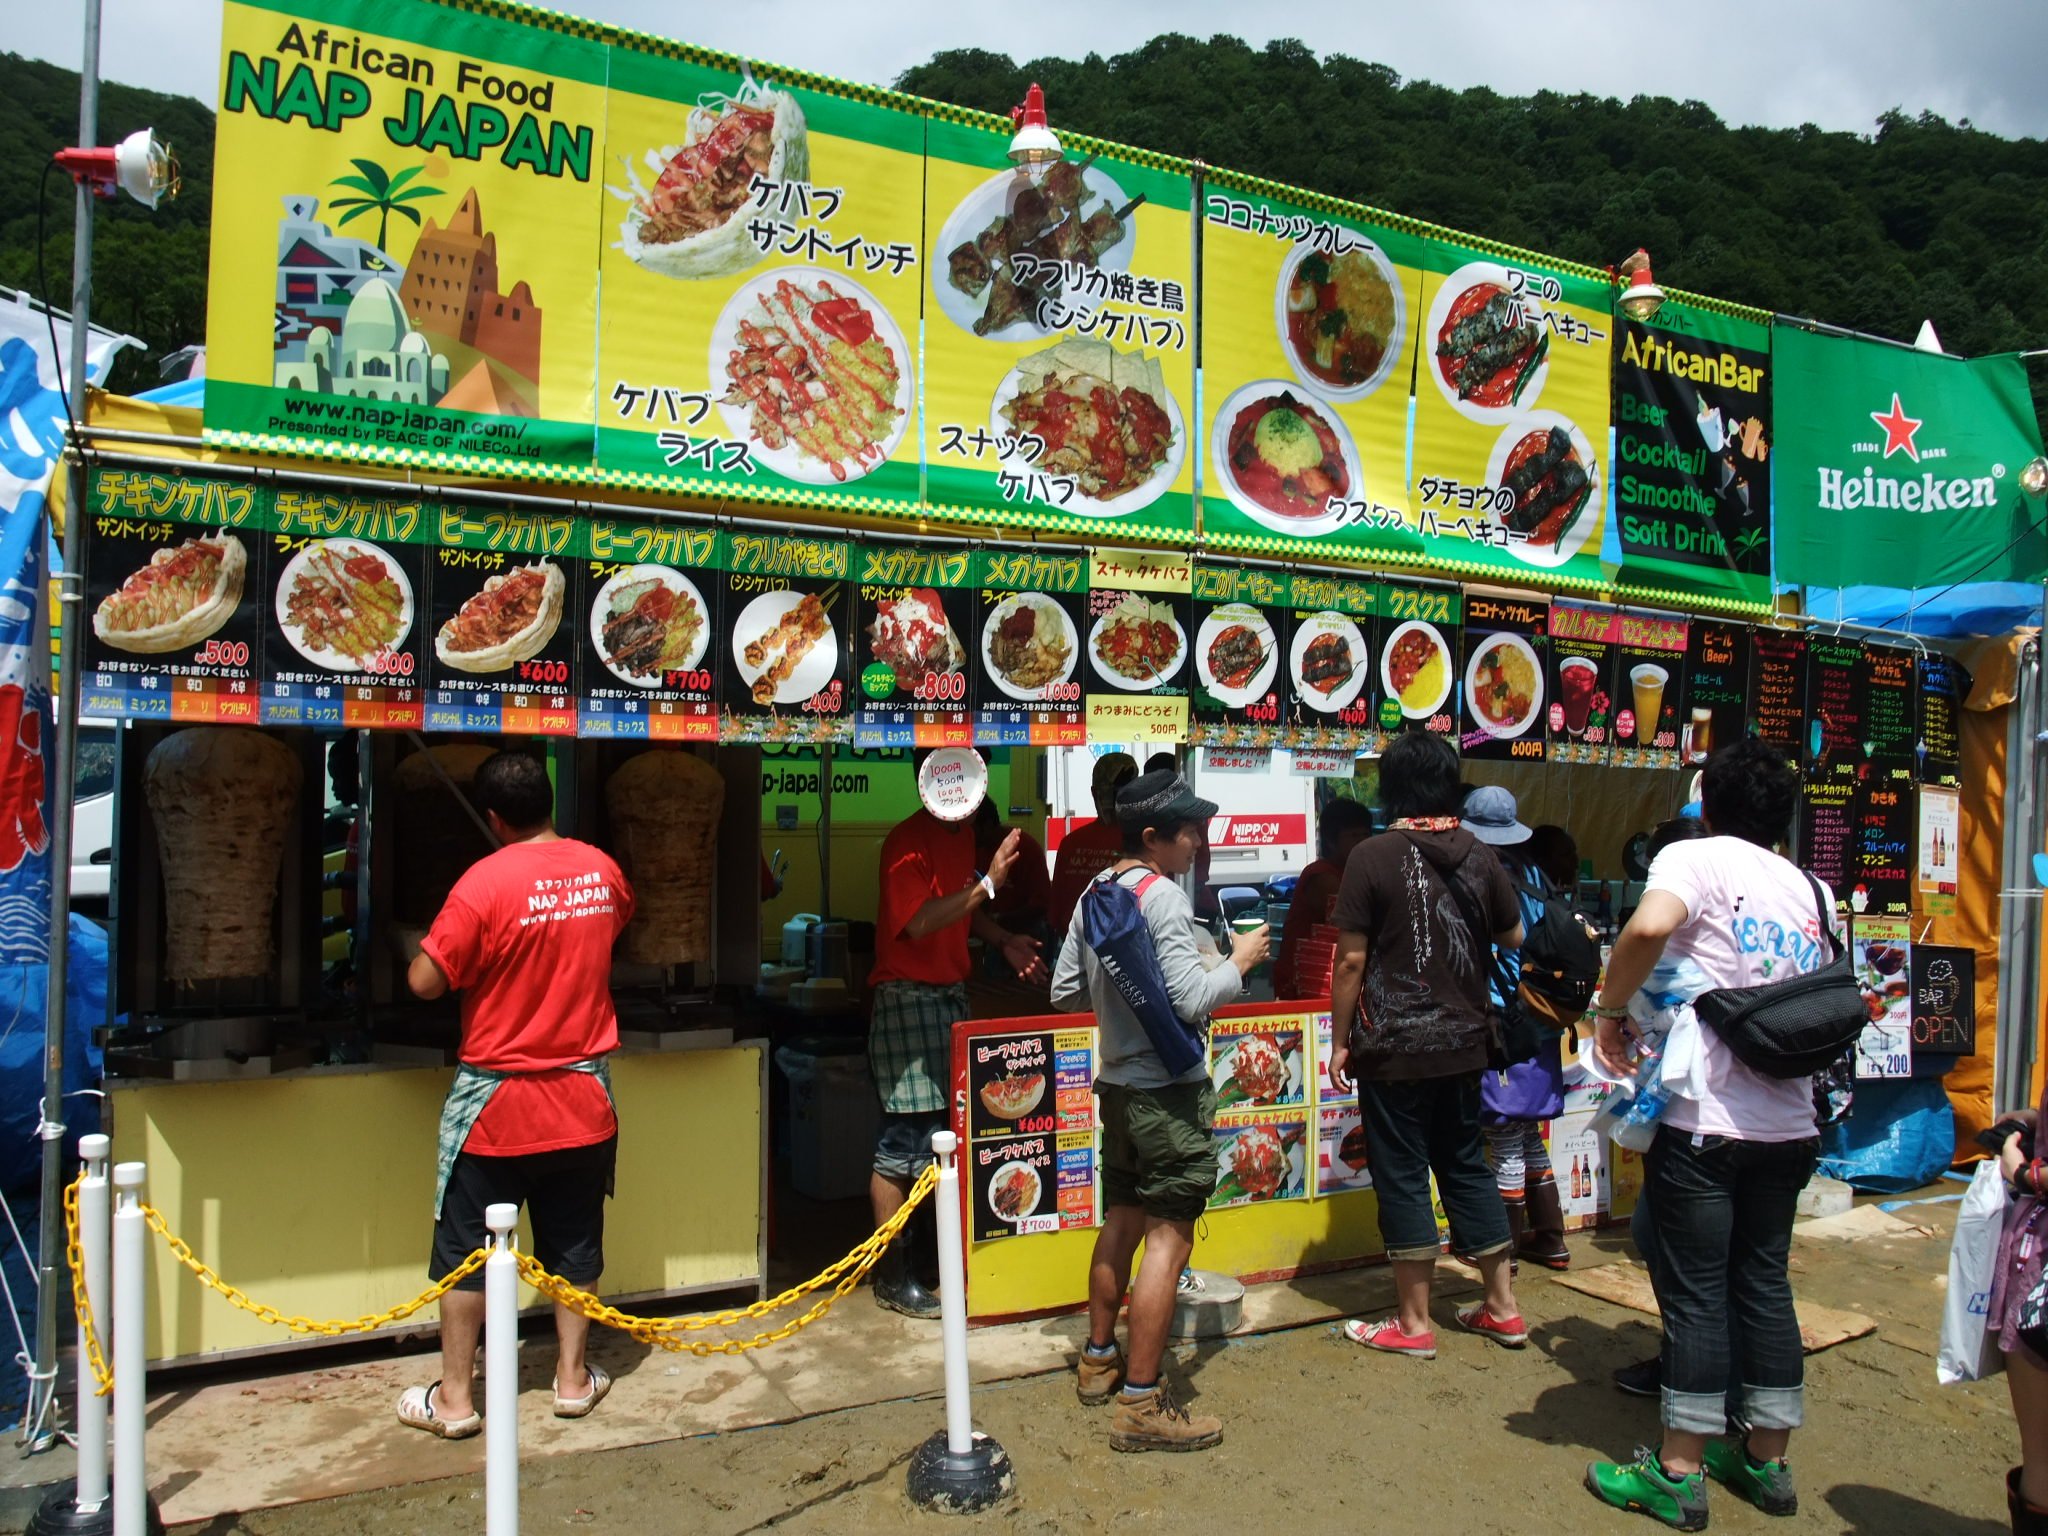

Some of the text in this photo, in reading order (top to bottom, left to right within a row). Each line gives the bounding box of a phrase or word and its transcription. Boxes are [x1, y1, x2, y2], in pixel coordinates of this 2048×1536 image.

[277, 22, 553, 112] African Food
[224, 51, 593, 182] NAP JAPAN
[749, 176, 844, 221] ケバブ
[1207, 195, 1376, 255] ココナッツカレー
[747, 219, 916, 275] サンドイッチ
[1011, 253, 1185, 312] アフリカ焼き鳥
[1505, 268, 1562, 302] ワニの
[1036, 298, 1186, 350] (シシケバブ)
[1503, 301, 1606, 345] バーベキュー
[1621, 331, 1765, 394] AfricanBar
[612, 382, 713, 425] ケバブ
[1621, 393, 1669, 427] Beer
[284, 397, 527, 439] www.nap-japan.com/
[268, 417, 347, 437] Presented
[354, 425, 371, 441] by
[375, 428, 428, 446] PEACE
[433, 433, 453, 449] OF
[939, 425, 1046, 463] スナック
[1852, 443, 1947, 459] TRADE MARK
[657, 432, 756, 475] ライス
[1621, 435, 1707, 475] Cocktail
[997, 469, 1078, 506] ケバブ
[1418, 475, 1515, 514] ダチョウの
[1621, 475, 1717, 517] Smoothie
[1818, 466, 1999, 513] Heineken
[98, 472, 256, 526] チキンケバブ
[275, 492, 421, 541] チキンケバブ
[1324, 495, 1413, 532] クスクス
[97, 518, 174, 542] サンドイッチ
[439, 505, 575, 554] ビーフケバブ
[1418, 510, 1529, 548] バーベキュー
[1623, 514, 1728, 556] Soft Drink
[275, 534, 328, 557] ライス
[590, 521, 717, 566] ビーフケバブ
[439, 549, 505, 570] サンドイッチ
[732, 535, 848, 578] アフリカやきとり
[590, 561, 634, 580] ライス
[861, 550, 969, 587] メガケバブ
[985, 554, 1082, 592] メガケバブ
[1097, 562, 1188, 581] スナックケバブ
[730, 575, 791, 592] (シシケバブ)
[1194, 567, 1284, 603] ワニのバーベキュー
[861, 585, 912, 602] サンドイッチ
[982, 589, 1019, 605] ライス
[1389, 587, 1449, 623] クスクス
[1470, 602, 1545, 623] ココナッツカレー
[1704, 631, 1733, 647] ビール
[194, 641, 250, 667] ¥500
[1702, 649, 1733, 666] (Beer)
[1810, 643, 1862, 659] ジンベースカクテル
[98, 661, 250, 678] お好きなソースをお選びください
[364, 649, 415, 676] ¥600
[276, 672, 415, 687] お好きなソースをお選びください
[520, 662, 568, 682] ¥600
[1694, 674, 1723, 685] 生ビール
[1761, 674, 1794, 683] ラムトニック
[1874, 665, 1901, 678] カクテル
[96, 674, 202, 691] 甘口 中辛 辛口
[440, 680, 567, 694] お好きなソースをお選びください
[667, 670, 711, 691] ¥700
[914, 672, 965, 700] ¥800
[1761, 684, 1793, 694] ラムオレンジ
[275, 685, 371, 700] 甘口 中辛 辛口
[438, 692, 527, 707] 甘口 中辛 辛口
[591, 689, 710, 700] お好きなソースをお選びください
[1038, 683, 1080, 701] ¥1,000
[1693, 691, 1741, 703] マンゴービール
[130, 699, 166, 712] ミックス
[802, 692, 841, 712] ¥400
[865, 702, 966, 710] お好きなソースをお選びください
[983, 703, 1079, 711] お好きなソースをお選びください
[1093, 704, 1180, 717] おつまみにどうぞ！
[307, 708, 339, 720] ミックス
[467, 714, 496, 726] ミックス
[982, 713, 992, 722] 甘口
[1246, 705, 1277, 720] ¥600
[1340, 709, 1366, 724] ¥600
[1759, 707, 1802, 717] ラムハイビスカス
[617, 720, 645, 732] ミックス
[1151, 723, 1177, 735] 500円
[1425, 714, 1451, 731] ¥600
[888, 732, 911, 741] ミックス
[1004, 731, 1026, 740] ミックス
[1584, 726, 1604, 742] ¥300
[1653, 732, 1675, 747] ¥300
[1512, 741, 1542, 757] 600円
[930, 762, 961, 777] 1000円
[1209, 758, 1266, 768] 空輸しました！！
[1295, 761, 1348, 771] 空輸しました！！
[1836, 765, 1854, 774] 500円
[762, 768, 868, 795] p-japa.com
[937, 775, 964, 787] 500円
[1891, 769, 1910, 779] 500円
[938, 786, 962, 798] 100円
[1803, 784, 1854, 796] いろいろカクテル
[1870, 791, 1897, 805] かき氷
[1232, 823, 1280, 836] NIPPON
[1865, 829, 1885, 838] メロン
[1864, 841, 1906, 853] ブルーハワイ
[1862, 854, 1891, 865] マンゴー
[1861, 868, 1906, 879] ハイビスカス
[528, 886, 609, 912] NAP JAPAN
[1887, 903, 1907, 912] 300円
[1919, 988, 1944, 1005] BAR
[1890, 1011, 1907, 1020] 300円
[1913, 1016, 1971, 1045] OPEN
[977, 1038, 1042, 1062] ビーフケバブ
[1887, 1054, 1907, 1073] 200
[1018, 1114, 1055, 1134] ¥600
[979, 1139, 1045, 1165] ビーフケバブ
[1028, 1155, 1051, 1167] ライス
[1021, 1220, 1052, 1231] ¥700
